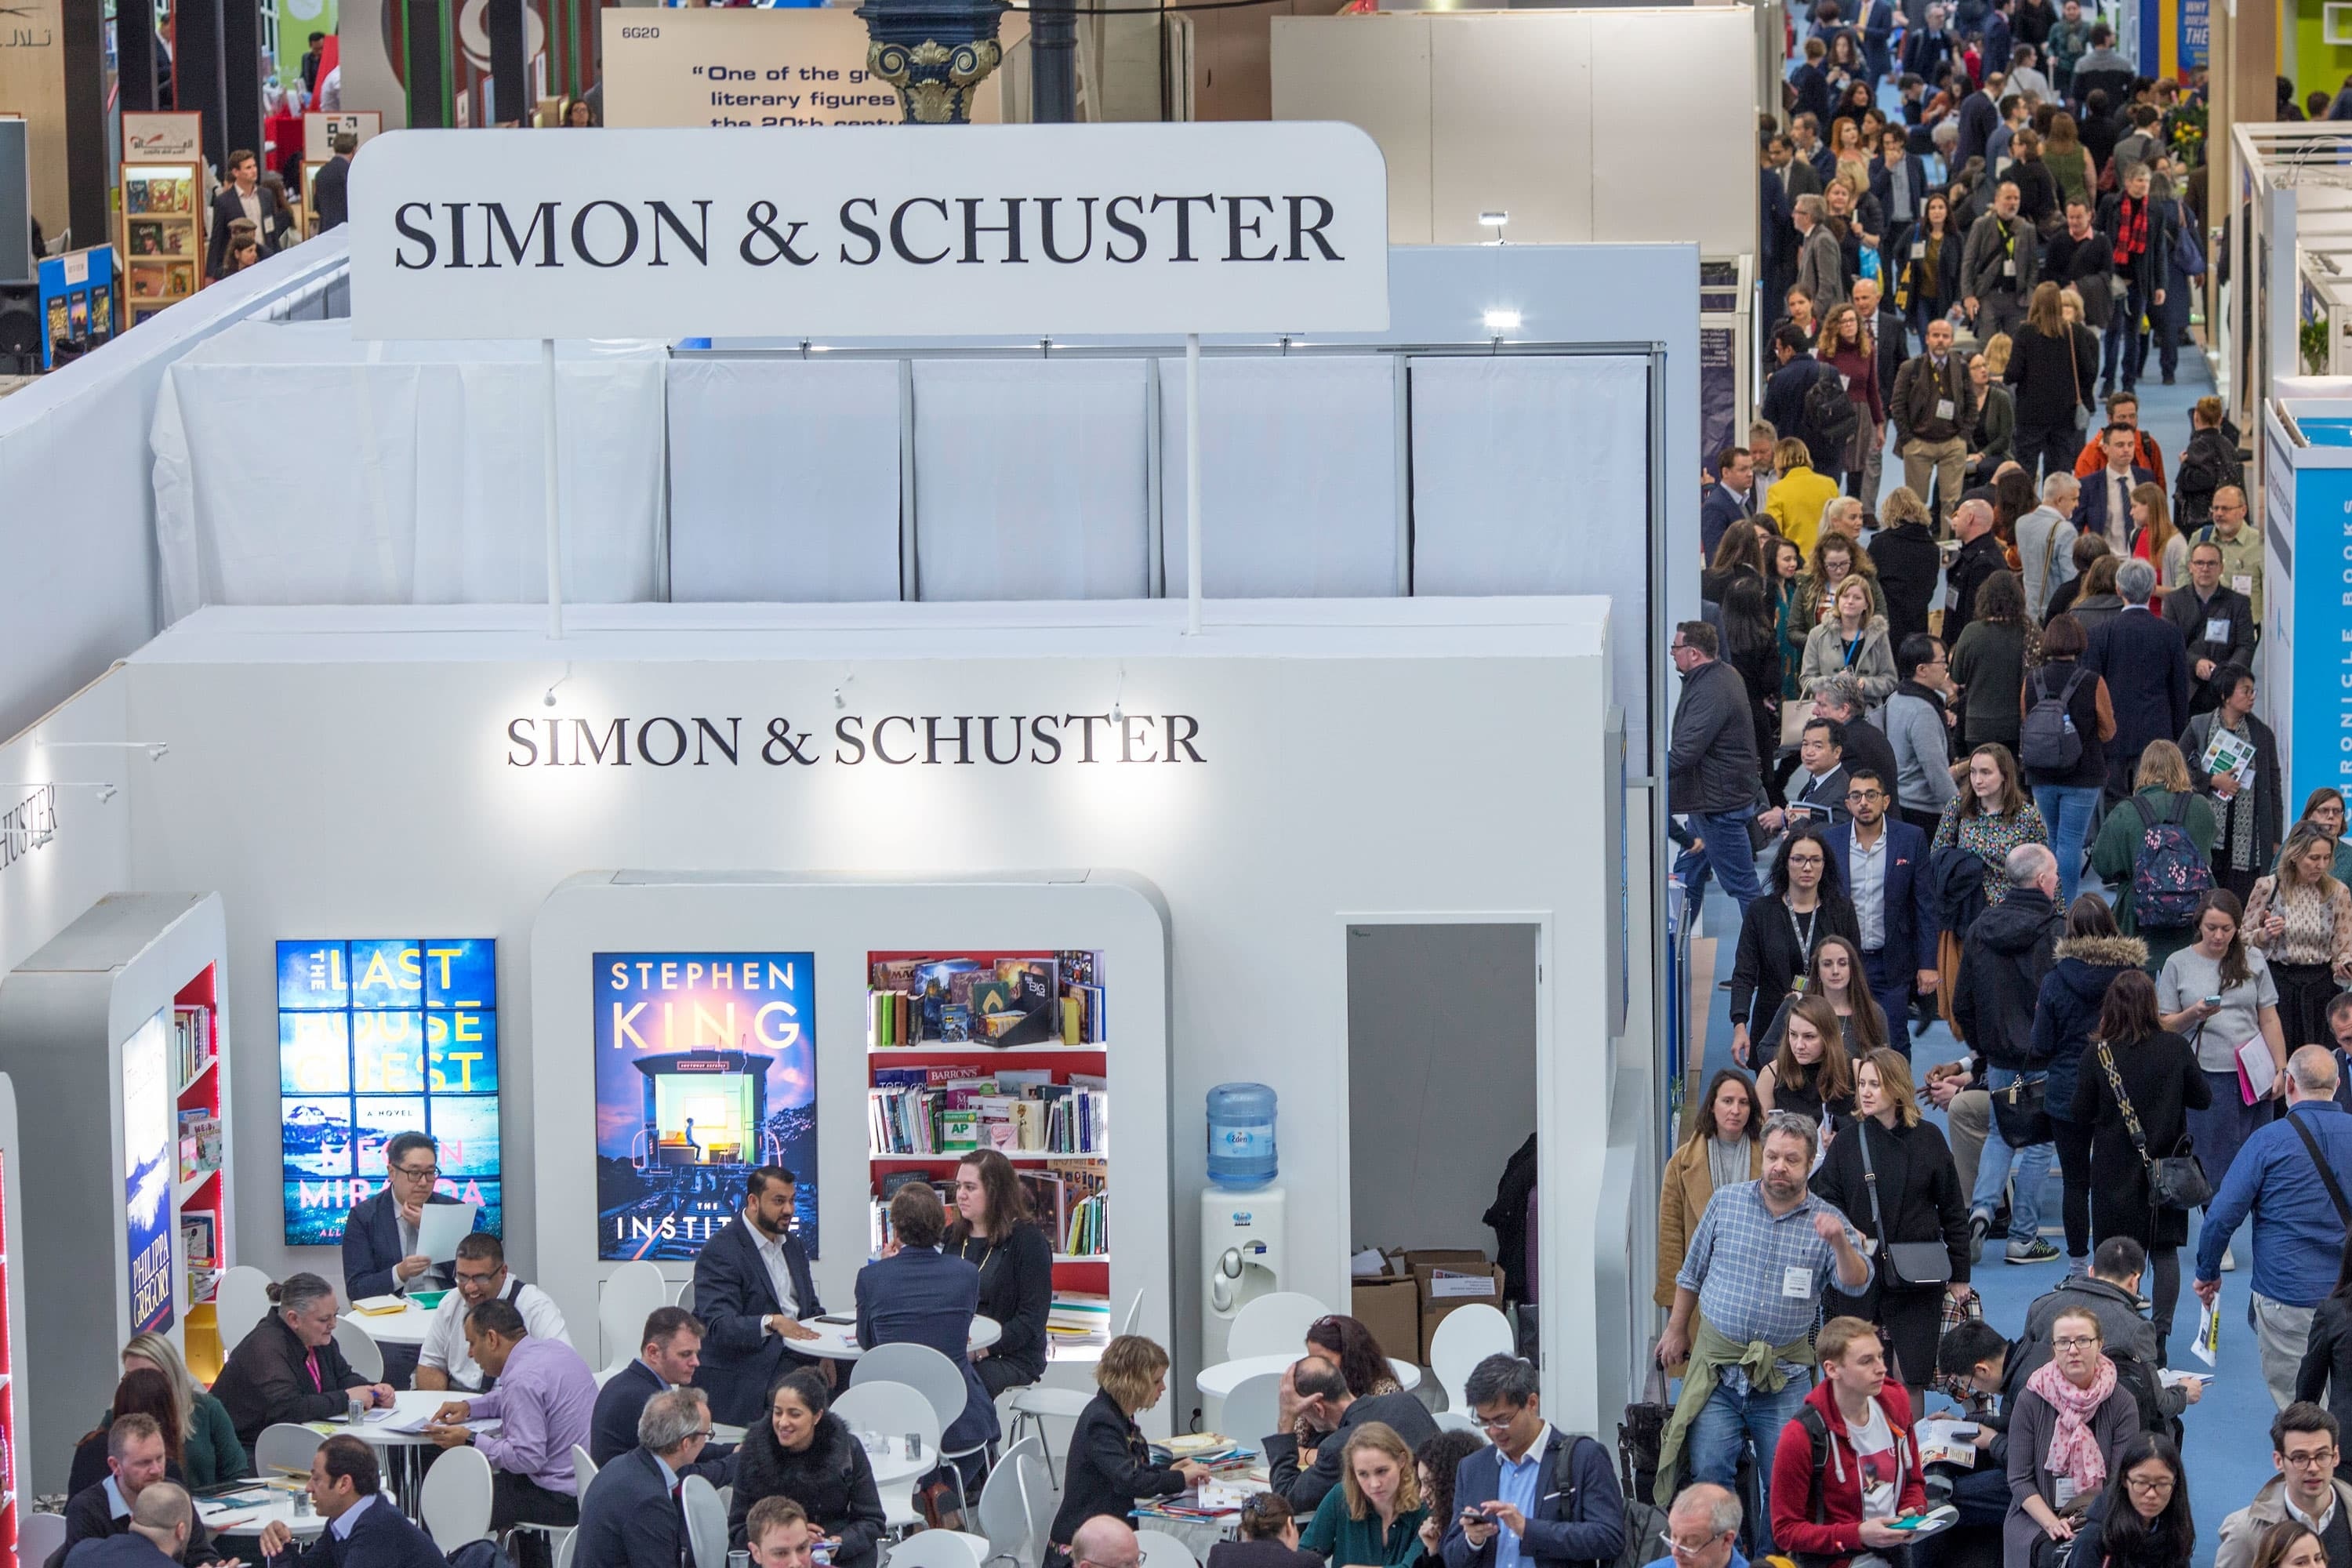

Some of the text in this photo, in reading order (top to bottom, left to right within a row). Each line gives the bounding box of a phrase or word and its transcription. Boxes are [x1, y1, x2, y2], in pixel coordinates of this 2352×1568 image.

[622, 27, 659, 38] 6G20
[766, 67, 789, 80] of
[800, 67, 840, 80] the
[711, 92, 895, 109] literary figures
[395, 194, 1345, 270] SIMON & SCHUSTER
[508, 713, 1207, 767] SIMON & SCHUSTER
[310, 949, 325, 990] THE
[330, 949, 463, 990] LAST
[611, 961, 794, 991] STEPHEN
[1029, 982, 1045, 993] BIG
[295, 1000, 483, 1042] HOUSE
[613, 1000, 800, 1049] KING
[295, 1052, 483, 1093] GUEST
[931, 1069, 978, 1080] BARRON'S
[951, 1123, 969, 1134] AP
[321, 1139, 463, 1168] MEN
[299, 1178, 486, 1208] MIRDA
[697, 1202, 718, 1210] THE
[132, 1229, 169, 1294] PHILIPPA
[133, 1261, 170, 1329] GREGORY
